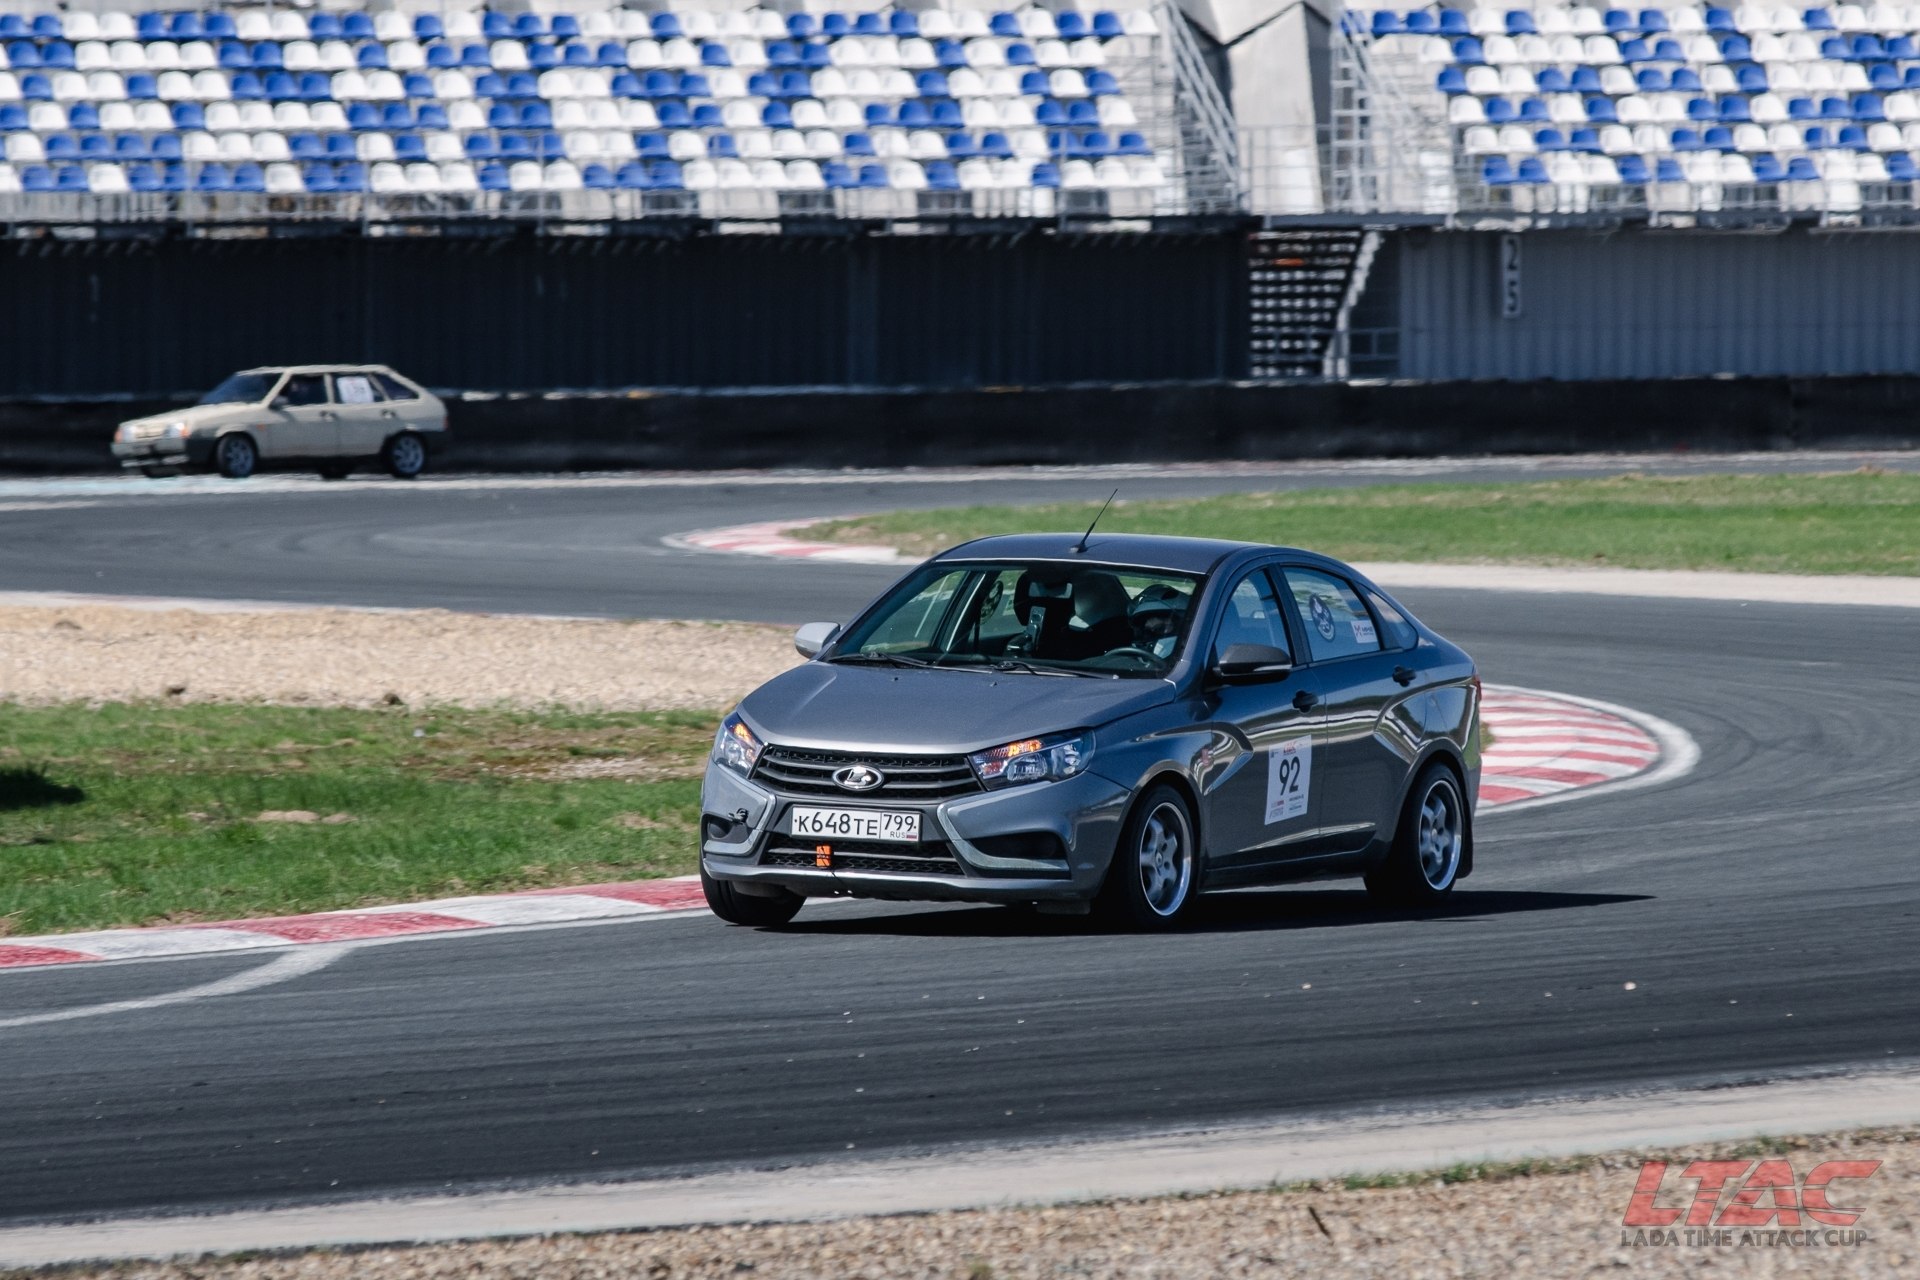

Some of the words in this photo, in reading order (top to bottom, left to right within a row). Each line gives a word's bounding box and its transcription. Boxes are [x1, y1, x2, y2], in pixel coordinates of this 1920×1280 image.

[1279, 756, 1301, 796] 92
[883, 814, 915, 832] 799
[890, 831, 906, 839] RUS
